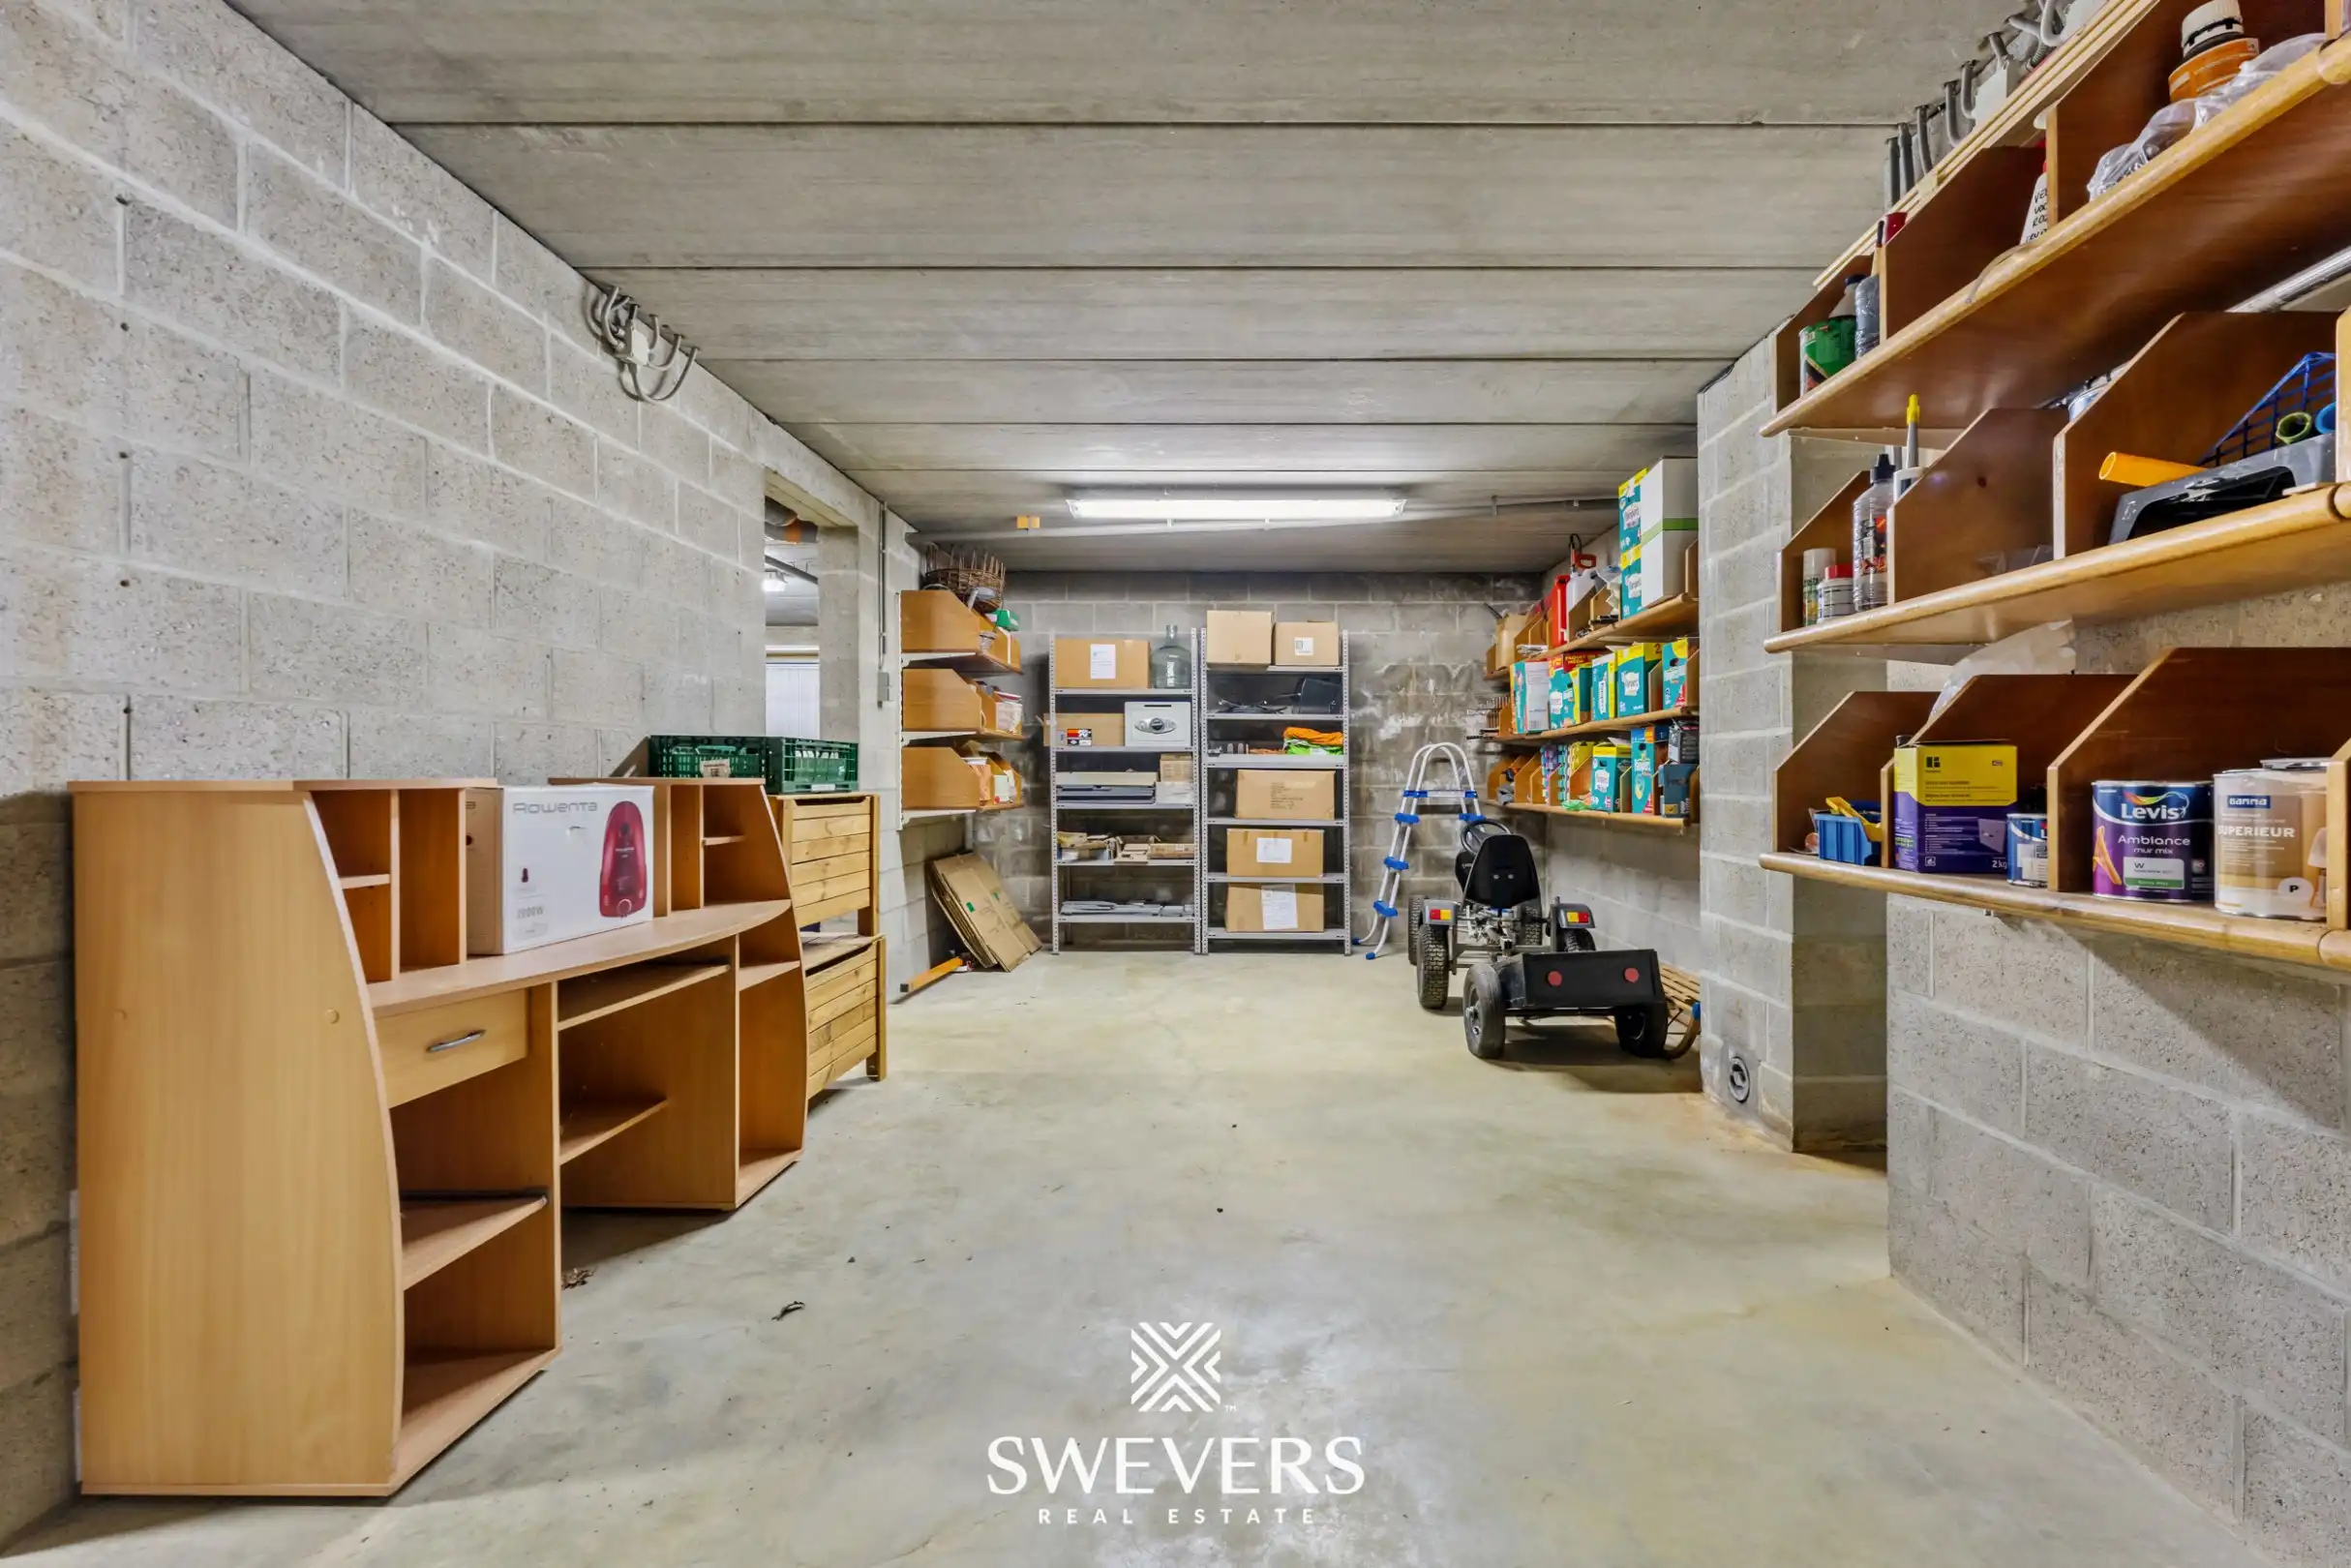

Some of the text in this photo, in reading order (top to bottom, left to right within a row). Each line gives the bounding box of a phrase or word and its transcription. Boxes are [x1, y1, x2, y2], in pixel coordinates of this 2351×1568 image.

[513, 801, 598, 814] Rowenta
[2121, 803, 2180, 820] Levis
[2217, 825, 2296, 837] SUPERIEUR
[2118, 834, 2190, 846] Ambiance
